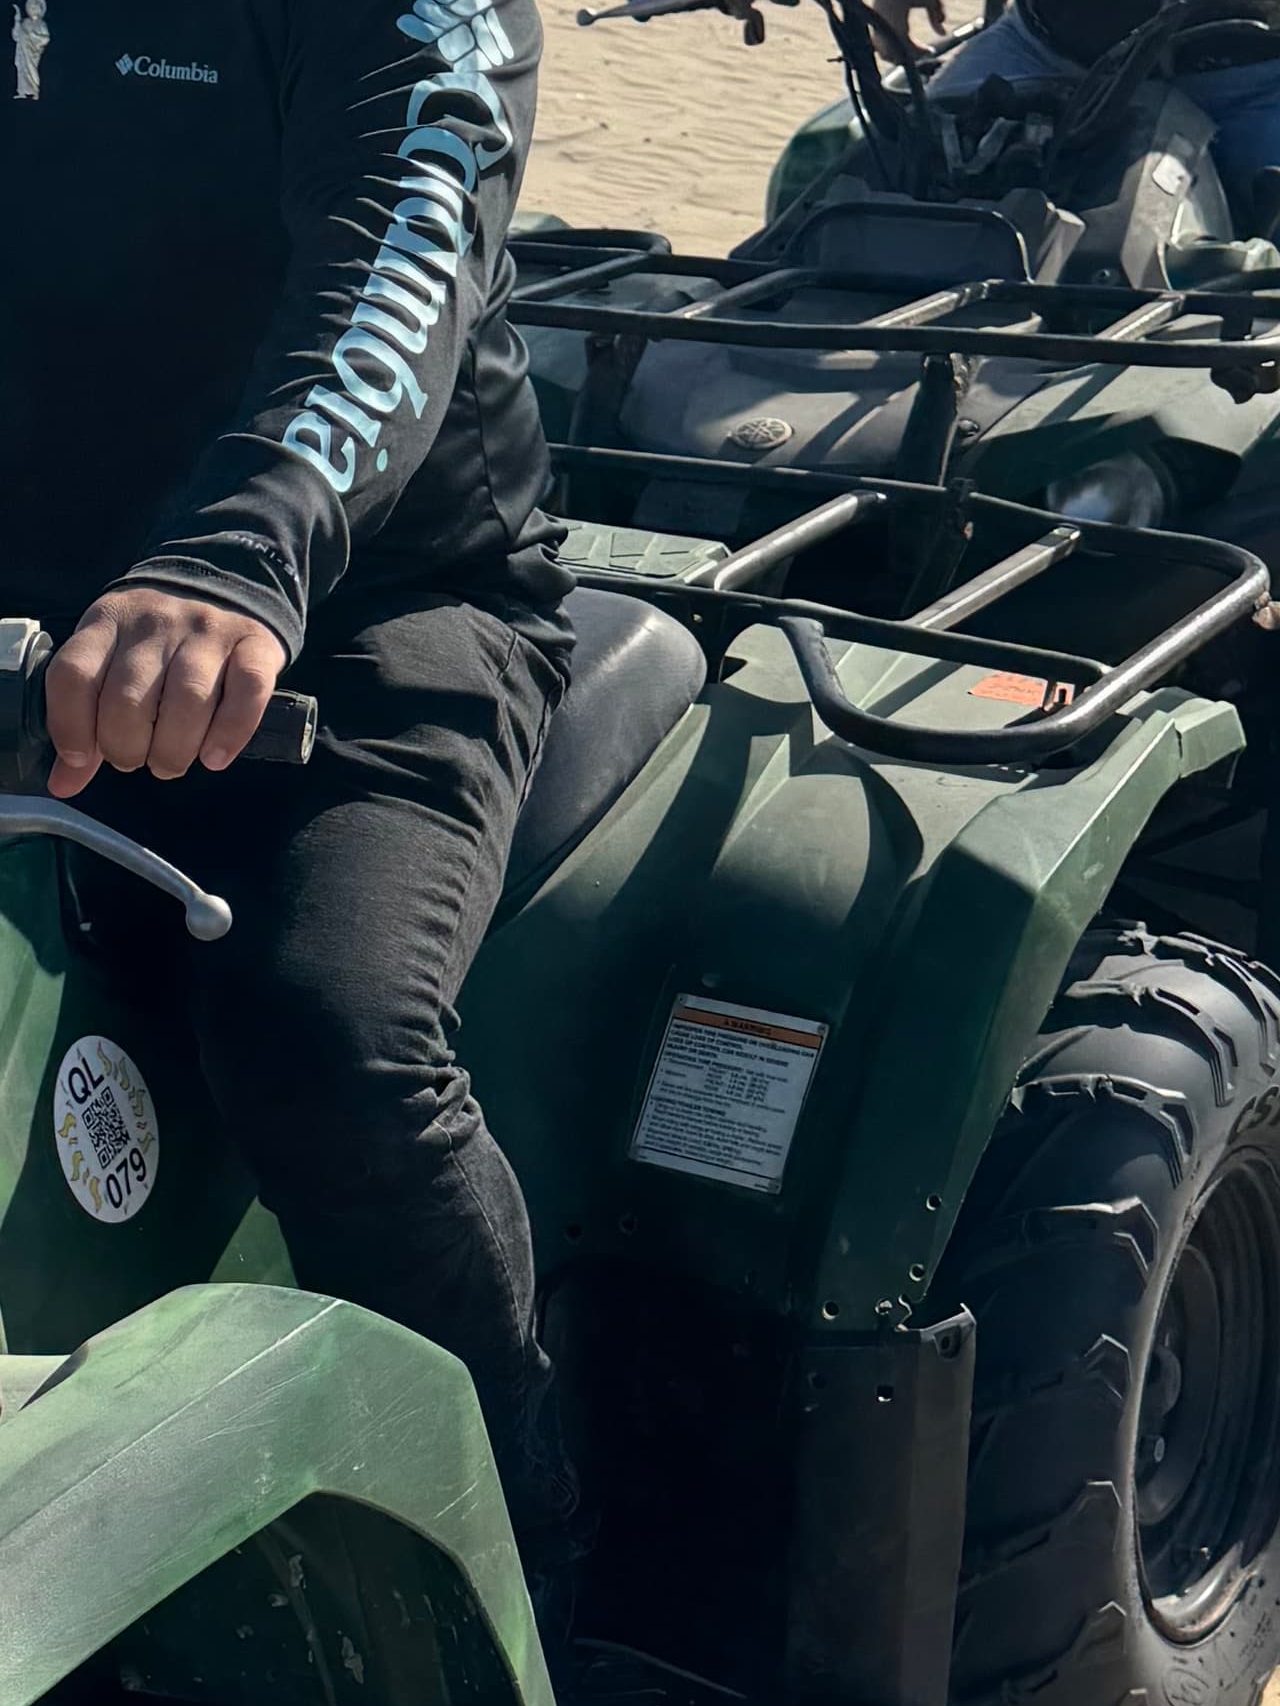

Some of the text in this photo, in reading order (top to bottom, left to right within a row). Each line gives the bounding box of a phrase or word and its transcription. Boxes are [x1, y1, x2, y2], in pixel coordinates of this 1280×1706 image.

[133, 55, 219, 84] Columbia
[68, 1056, 104, 1106] QL
[105, 1147, 147, 1209] 079
